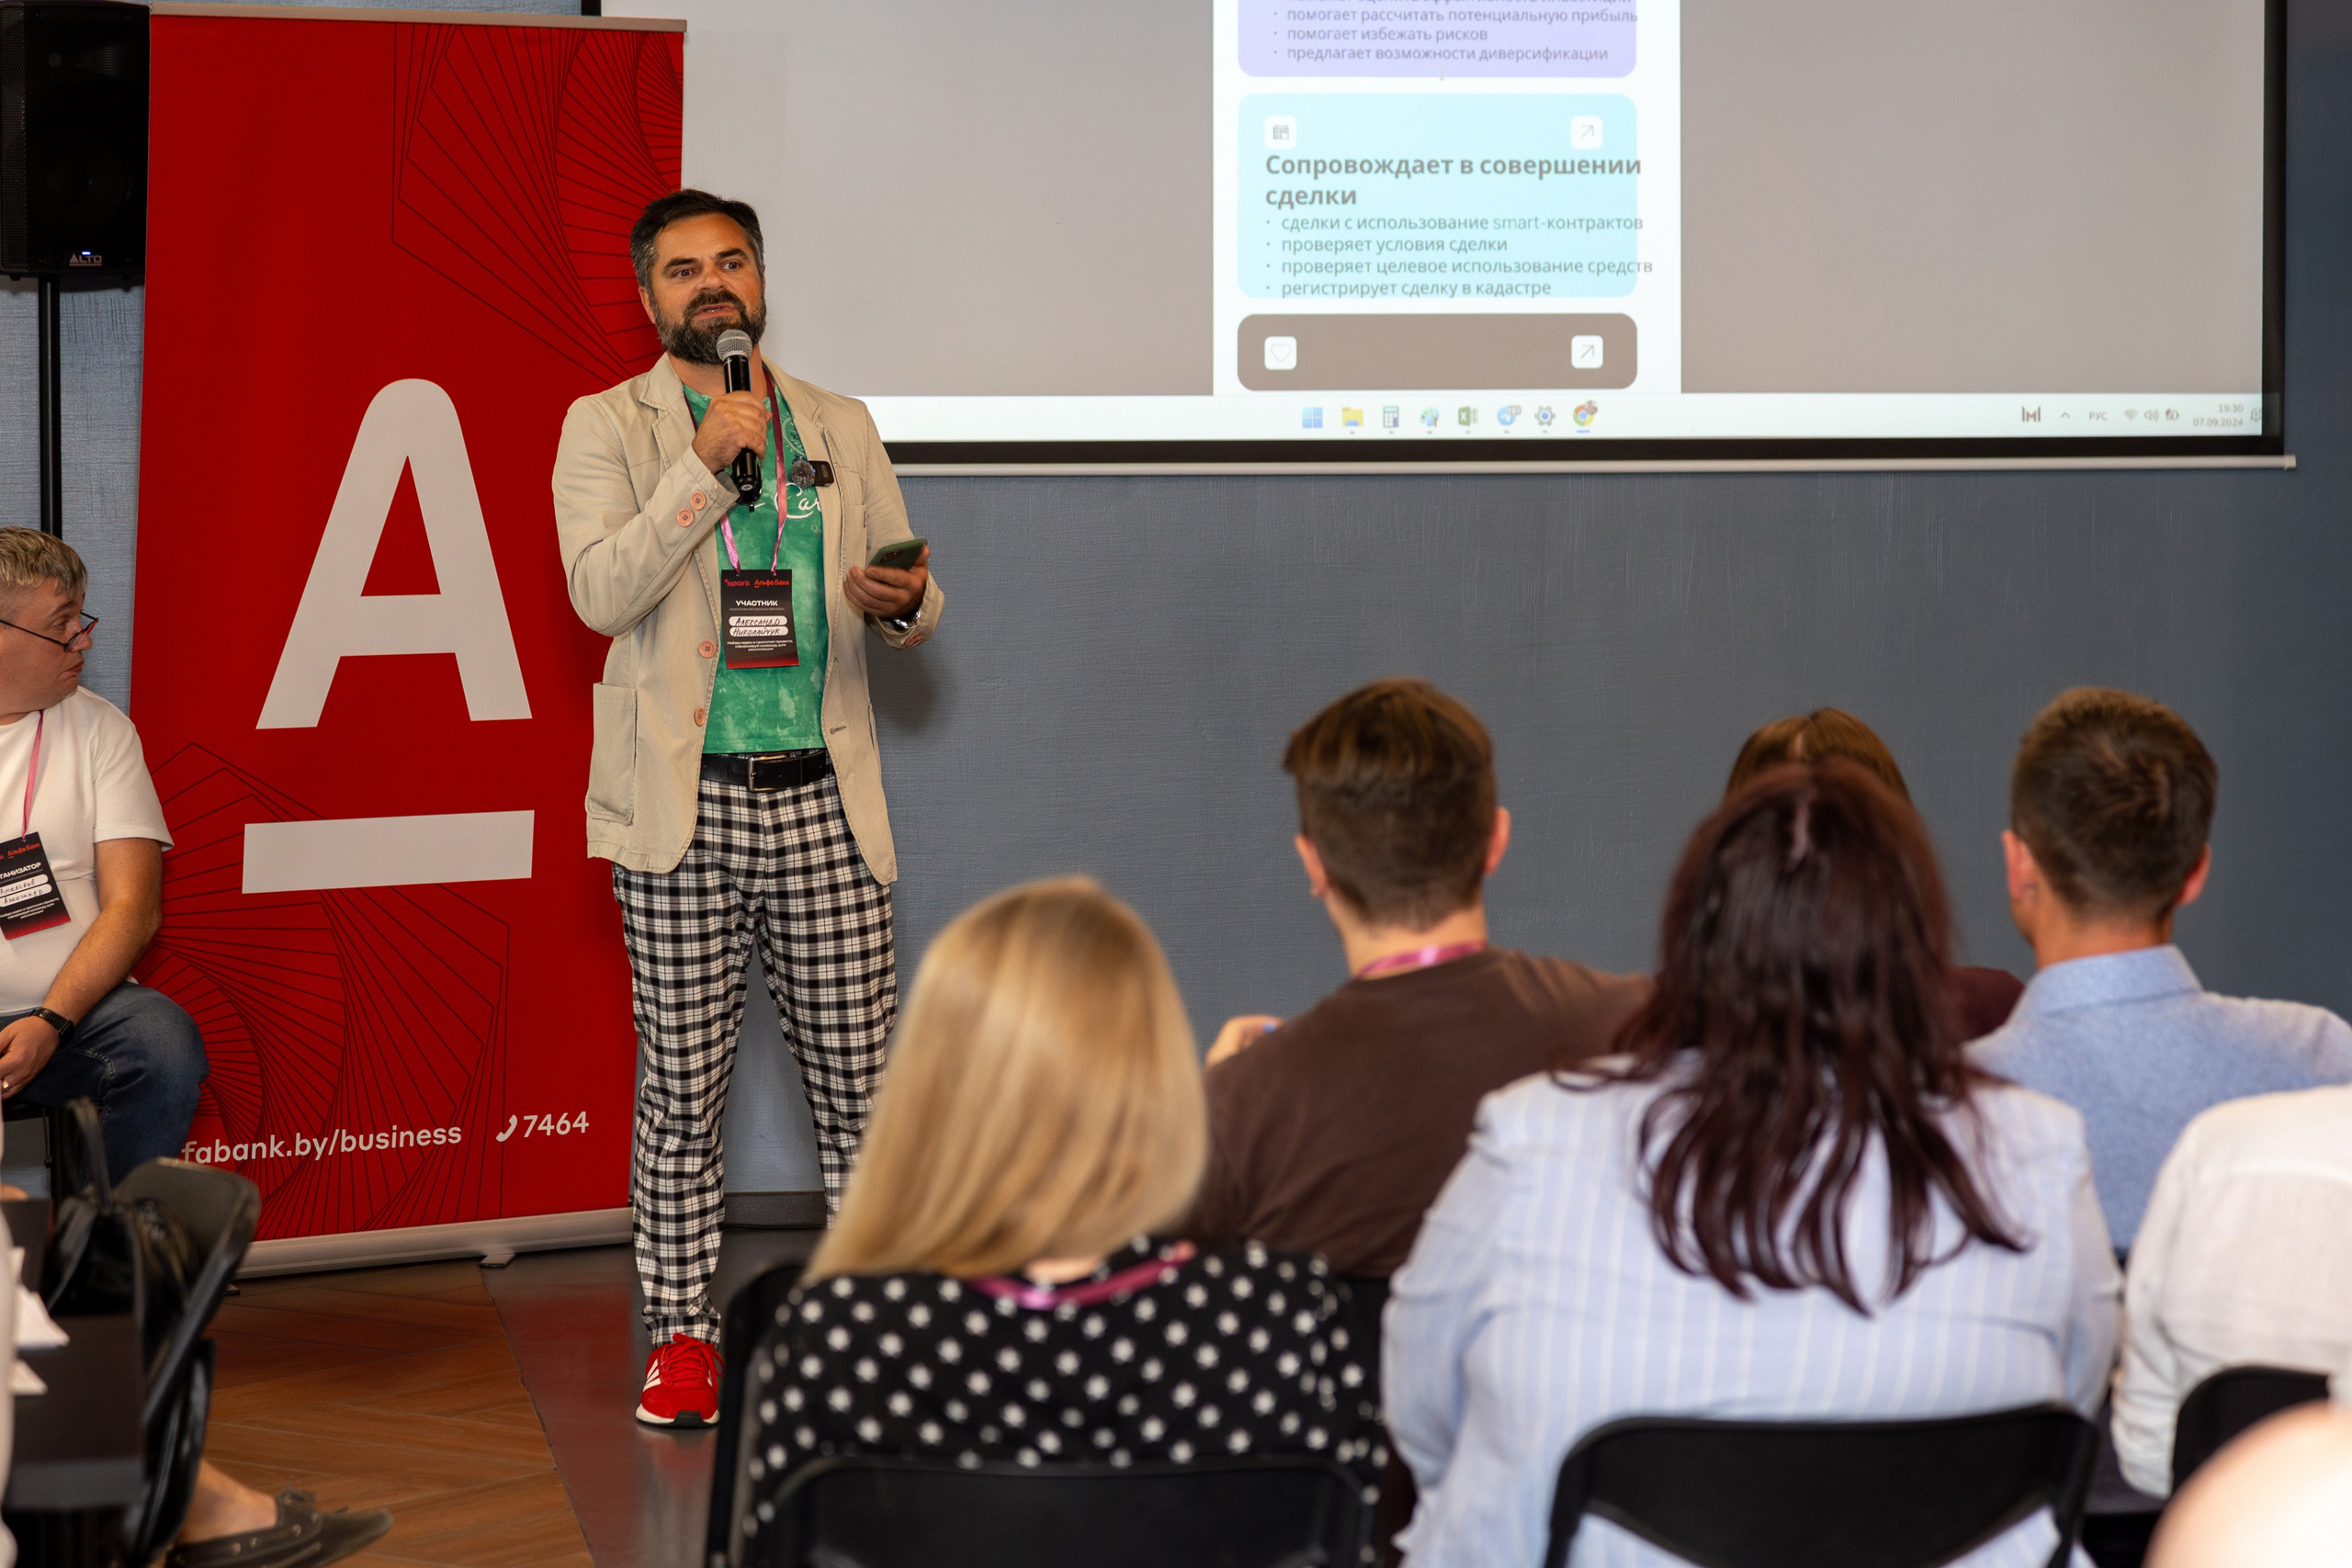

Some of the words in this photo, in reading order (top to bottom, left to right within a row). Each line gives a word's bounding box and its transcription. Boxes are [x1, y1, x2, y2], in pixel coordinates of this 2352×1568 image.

[1287, 10, 1358, 21] помогает
[1362, 10, 1444, 24] рассчитать
[1449, 10, 1567, 25] потенциальную
[1571, 8, 1638, 24] прибыль
[1287, 29, 1358, 40] помогает
[1362, 28, 1431, 40] избежать
[1436, 29, 1488, 43] рисков
[1287, 49, 1372, 62] предлагает
[1375, 49, 1476, 60] возможности
[1478, 47, 1609, 62] диверсификации
[1266, 155, 1454, 181] Сопровождает
[1461, 160, 1474, 175] в
[1480, 159, 1642, 181] совершении
[1266, 189, 1357, 210] сделки
[1282, 218, 1340, 232] сделки
[1344, 218, 1353, 230] с
[1357, 218, 1489, 230] использование
[1493, 215, 1644, 233] smart-контрактов
[1282, 240, 1372, 255] проверяет
[1376, 240, 1445, 255] условия
[1449, 240, 1508, 254] сделки
[1282, 261, 1373, 276] проверяет
[1377, 261, 1448, 276] целевое
[1452, 261, 1584, 274] использование
[1588, 261, 1654, 276] средств
[1282, 283, 1397, 299] регистрирует
[1401, 283, 1458, 299] сделку
[1463, 284, 1472, 295] в
[1476, 283, 1552, 298] кадастре
[523, 1111, 590, 1138] 7464
